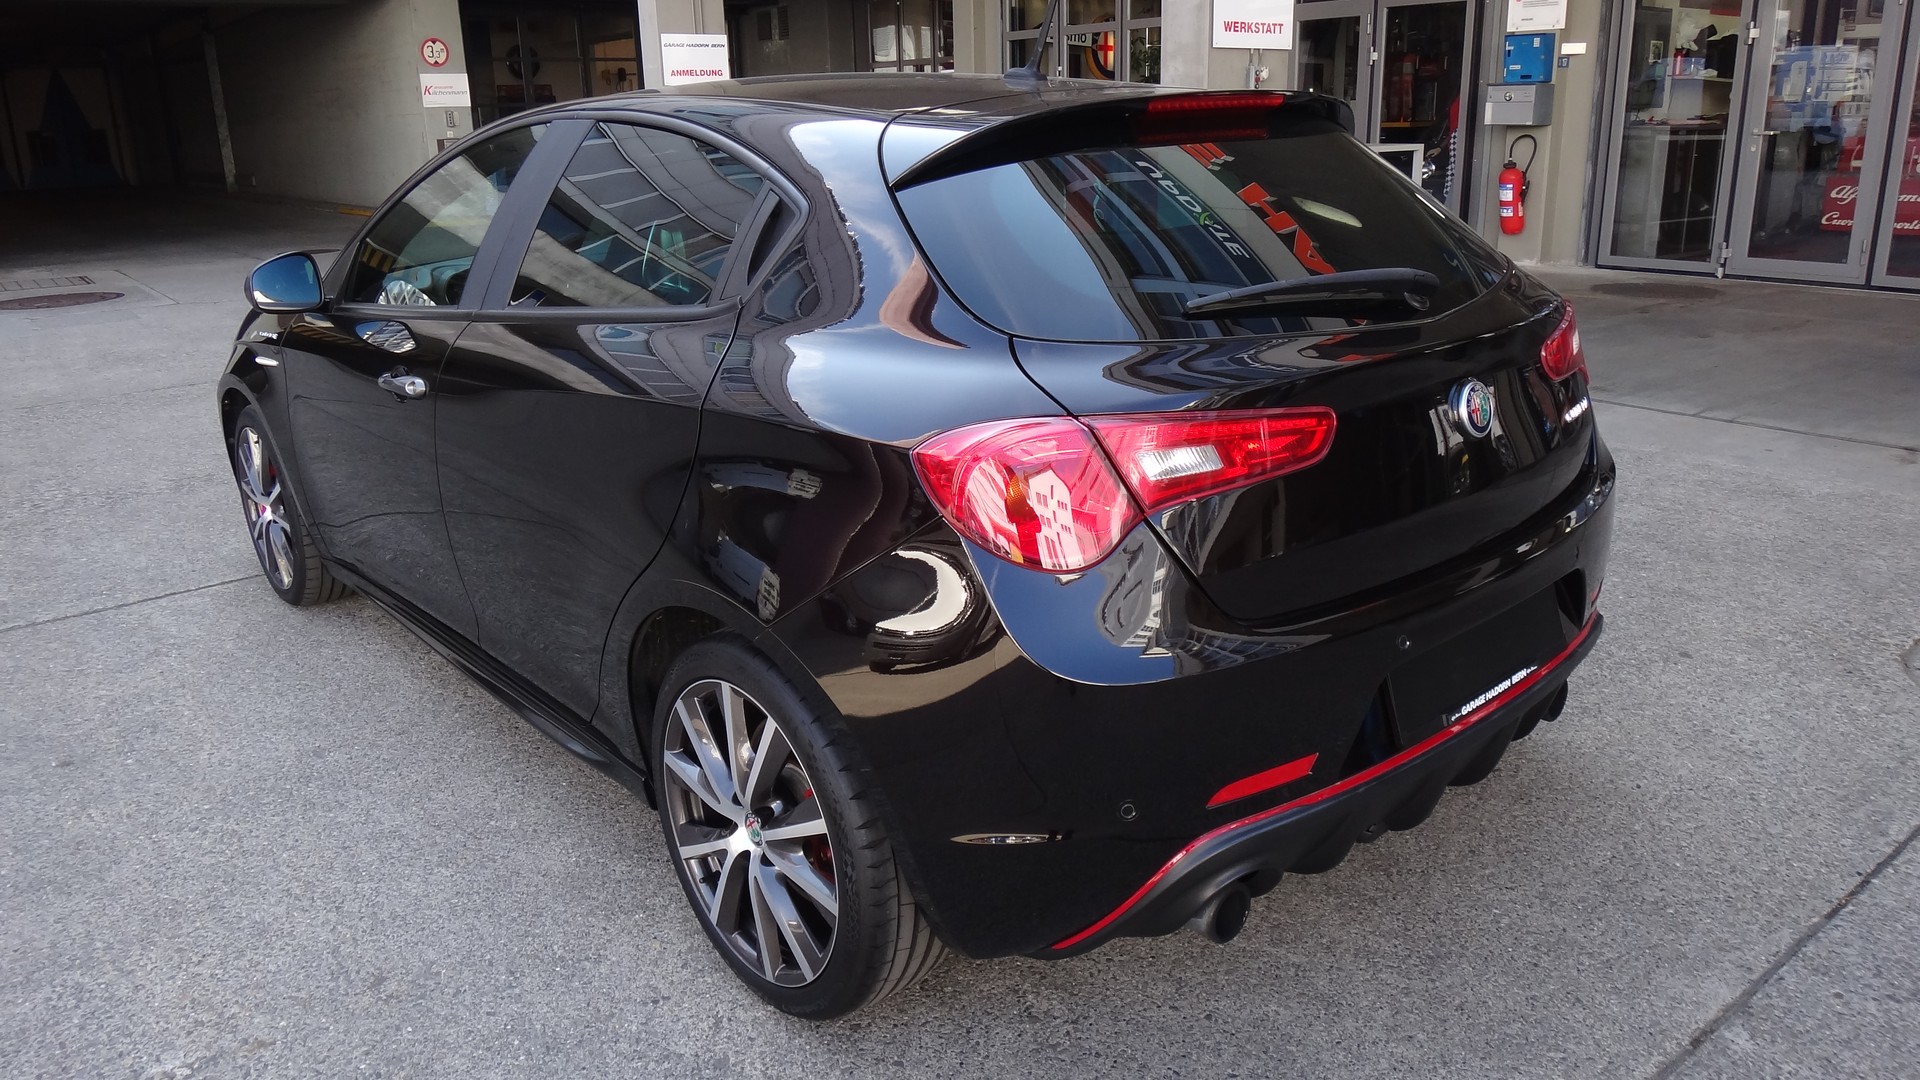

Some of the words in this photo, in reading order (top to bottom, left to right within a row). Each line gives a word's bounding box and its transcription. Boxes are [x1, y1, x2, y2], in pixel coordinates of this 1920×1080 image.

[1223, 20, 1284, 34] WERKSTATT
[670, 69, 723, 77] ANMELDUNG
[1821, 211, 1855, 226] Cuor
[1461, 694, 1486, 716] GARAGE
[1485, 679, 1511, 701] HADORN
[1511, 668, 1527, 685] BERN
